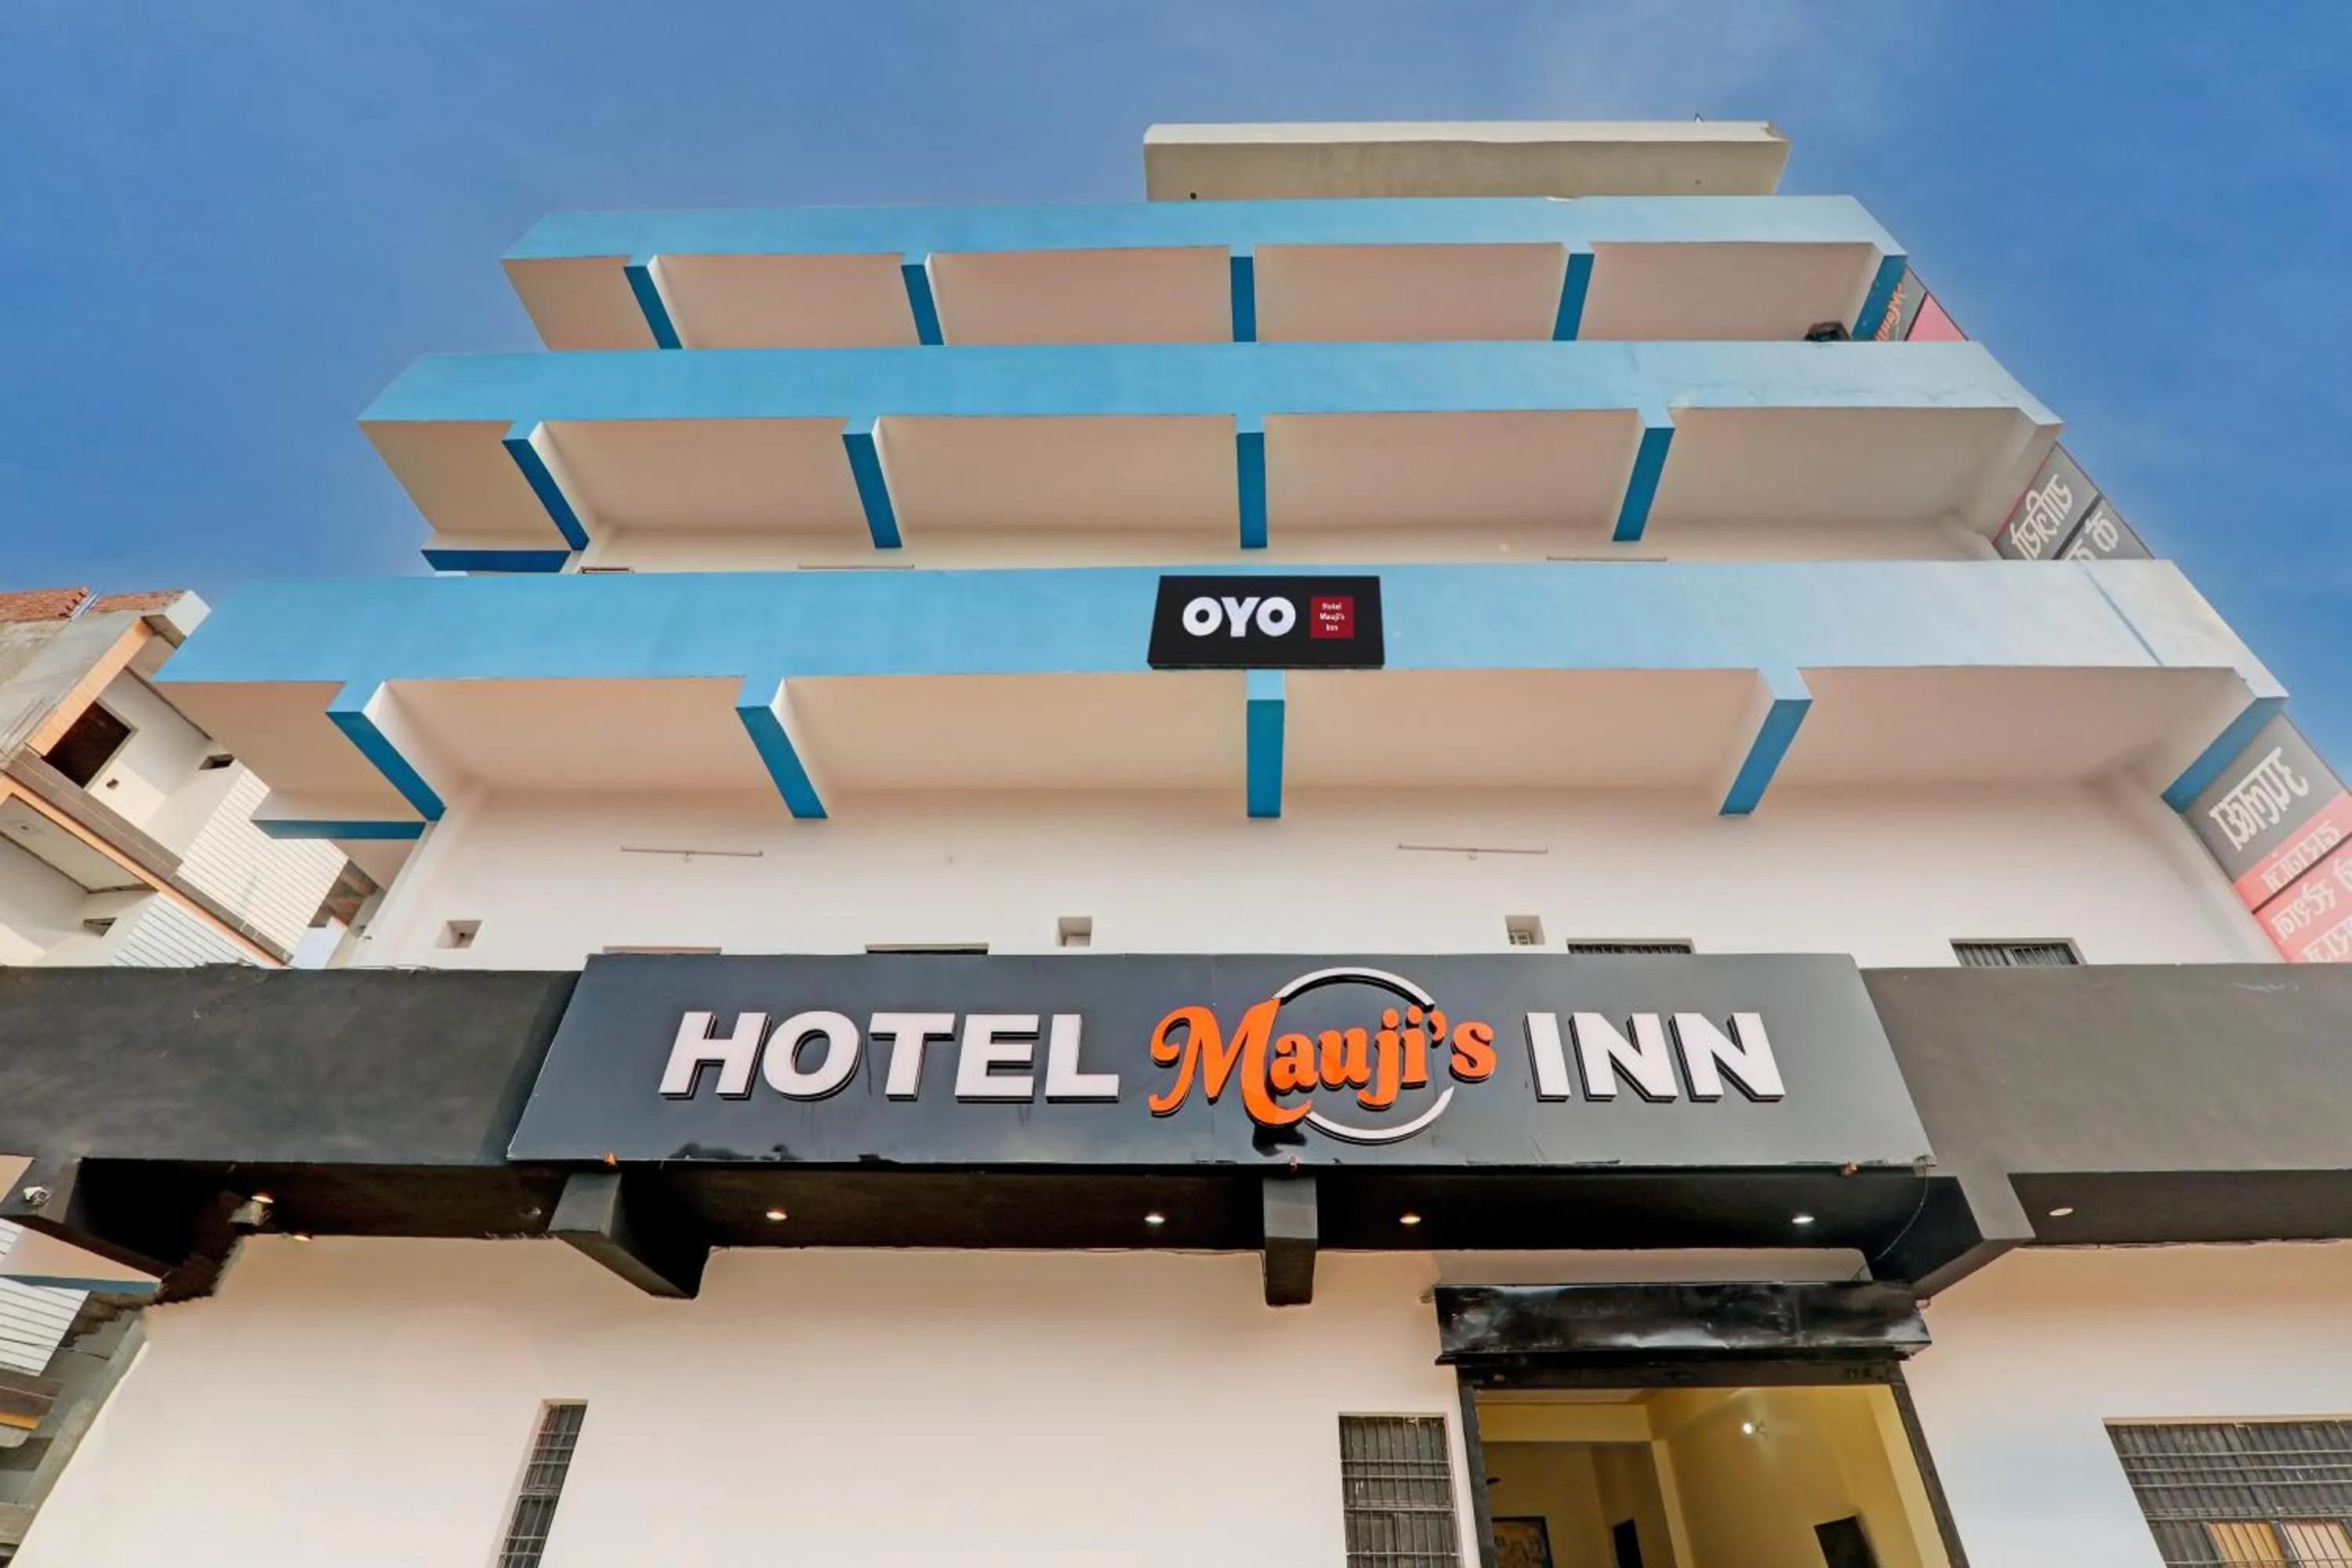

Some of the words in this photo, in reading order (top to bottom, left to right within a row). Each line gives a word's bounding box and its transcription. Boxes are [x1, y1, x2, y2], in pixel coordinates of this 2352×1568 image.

[1182, 597, 1296, 637] OYO
[1323, 602, 1341, 611] Hotel
[657, 1011, 1120, 1102] HOTEL
[1149, 996, 1497, 1128] Mauji's
[1525, 1011, 1786, 1102] INN
